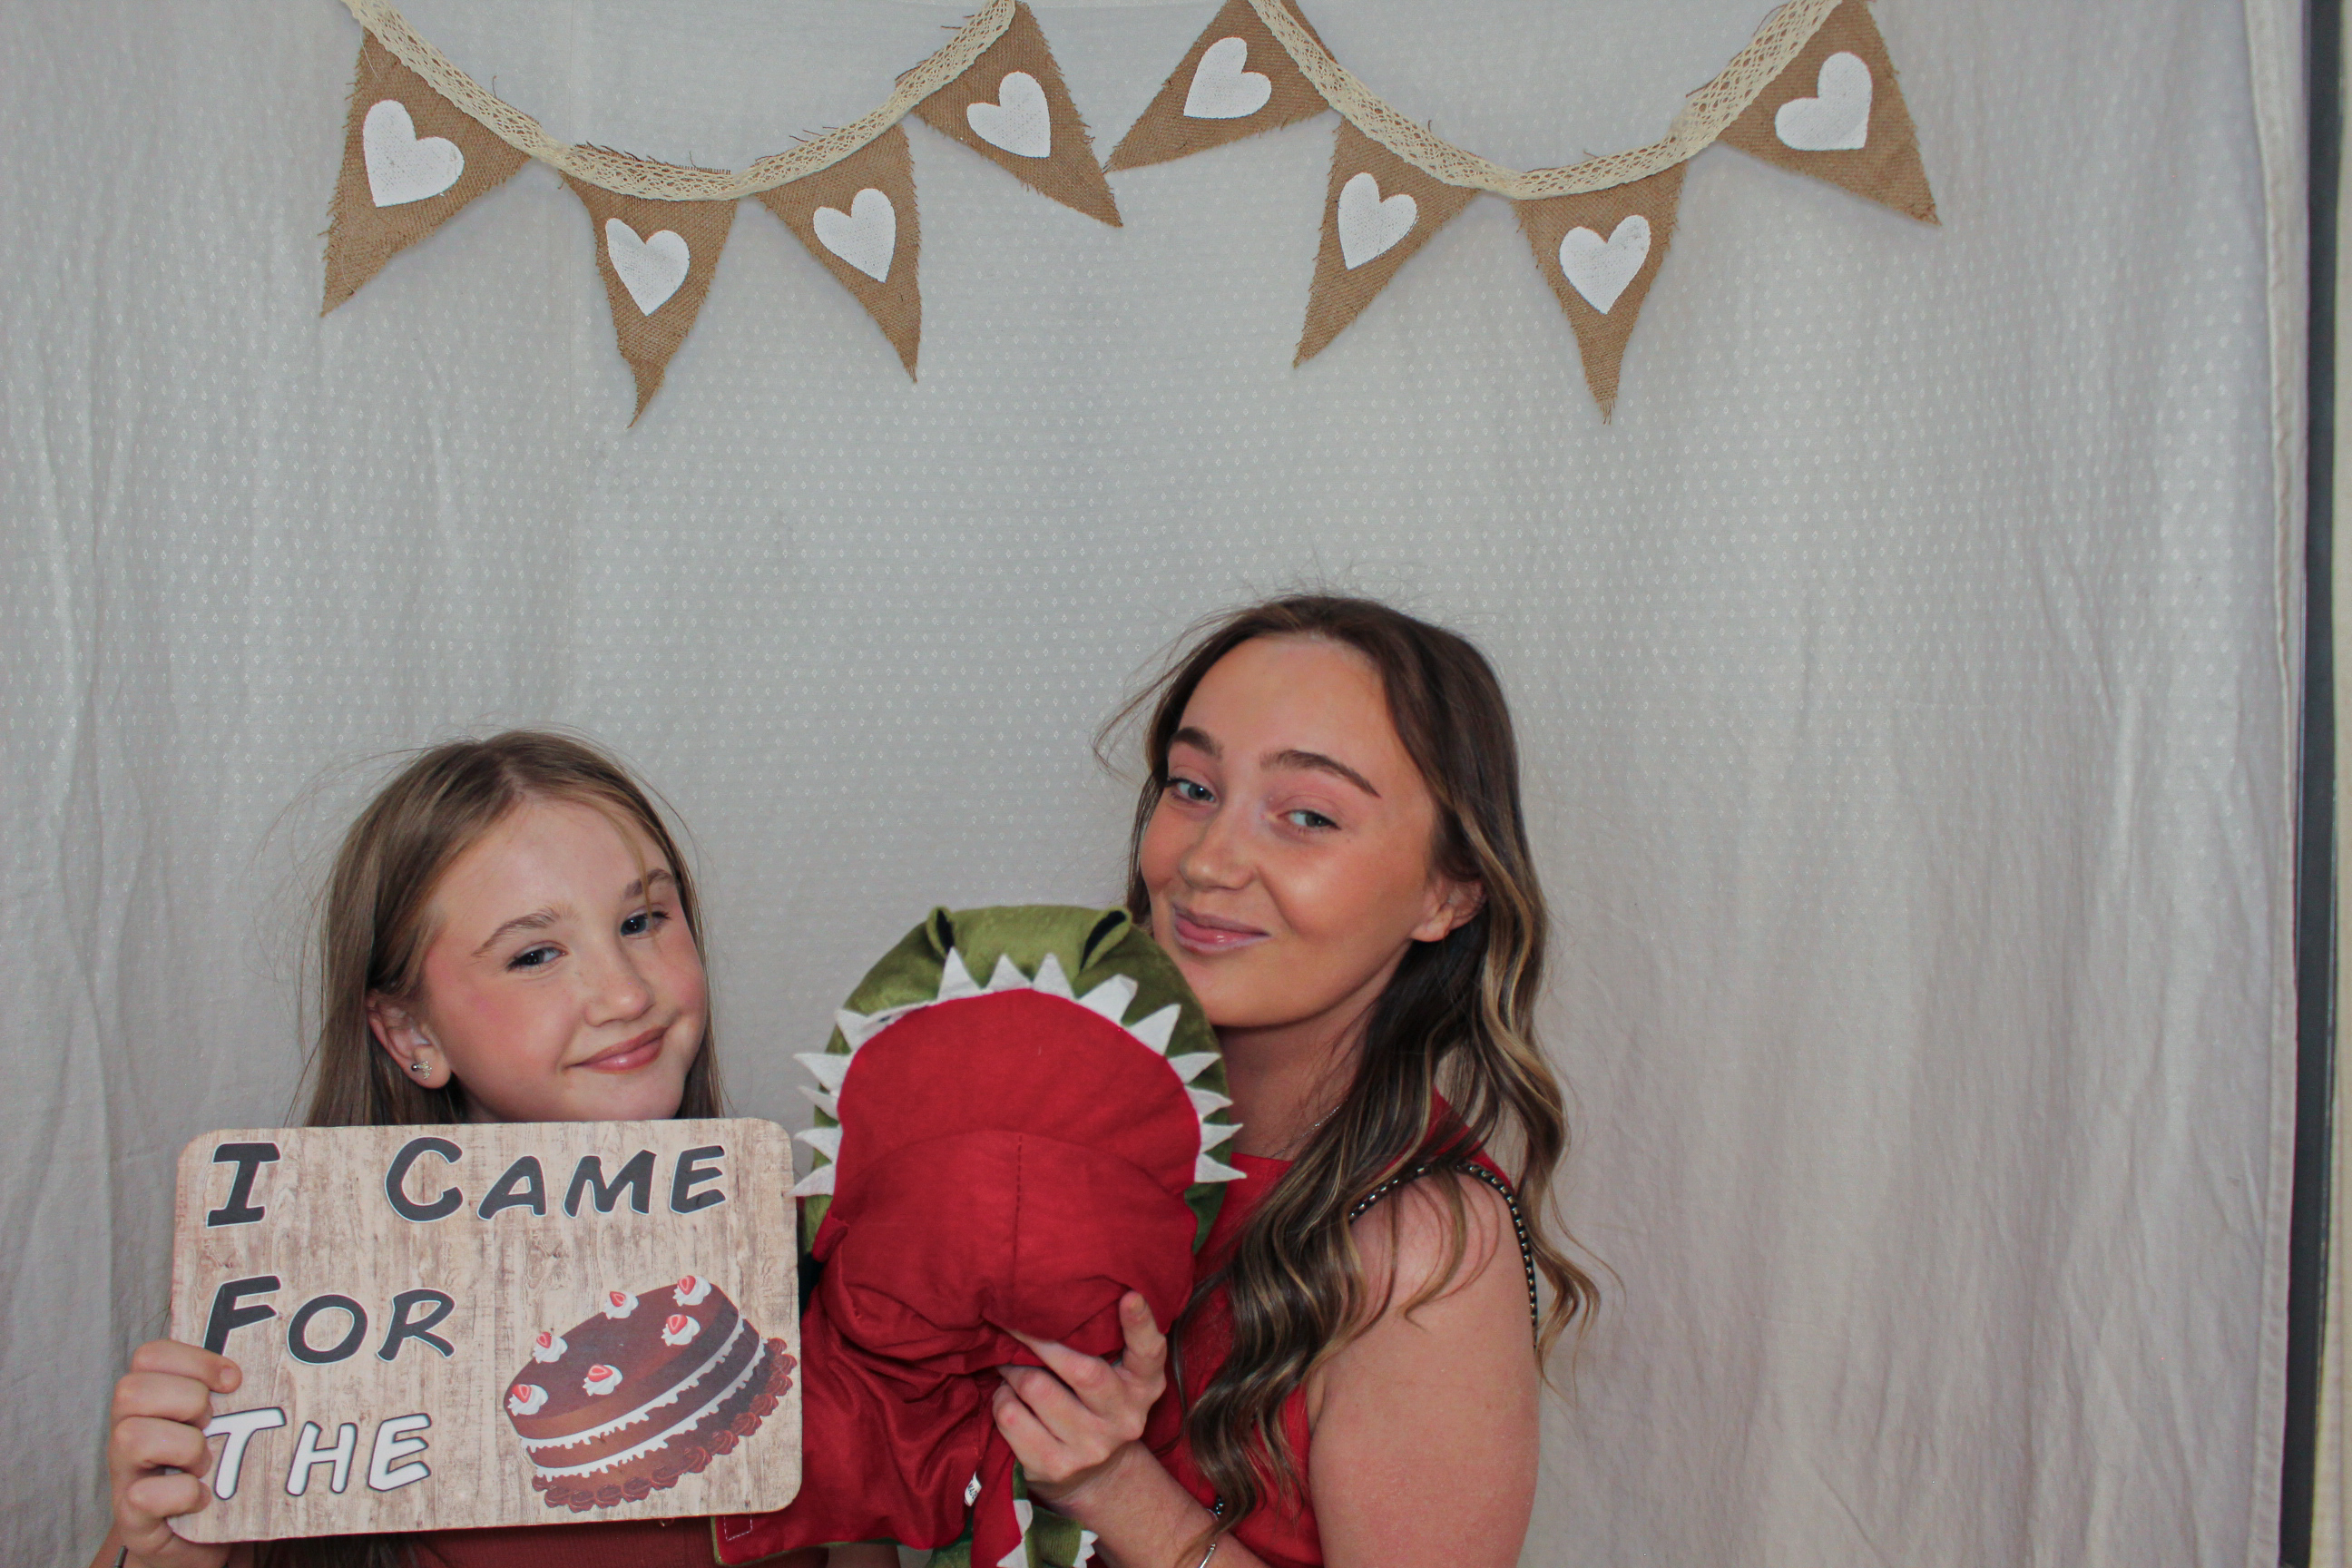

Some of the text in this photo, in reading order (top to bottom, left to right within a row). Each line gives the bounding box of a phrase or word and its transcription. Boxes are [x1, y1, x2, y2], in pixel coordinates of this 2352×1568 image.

[207, 1137, 726, 1227] I CAME
[203, 1275, 455, 1364] FOR
[204, 1406, 432, 1500] THE
